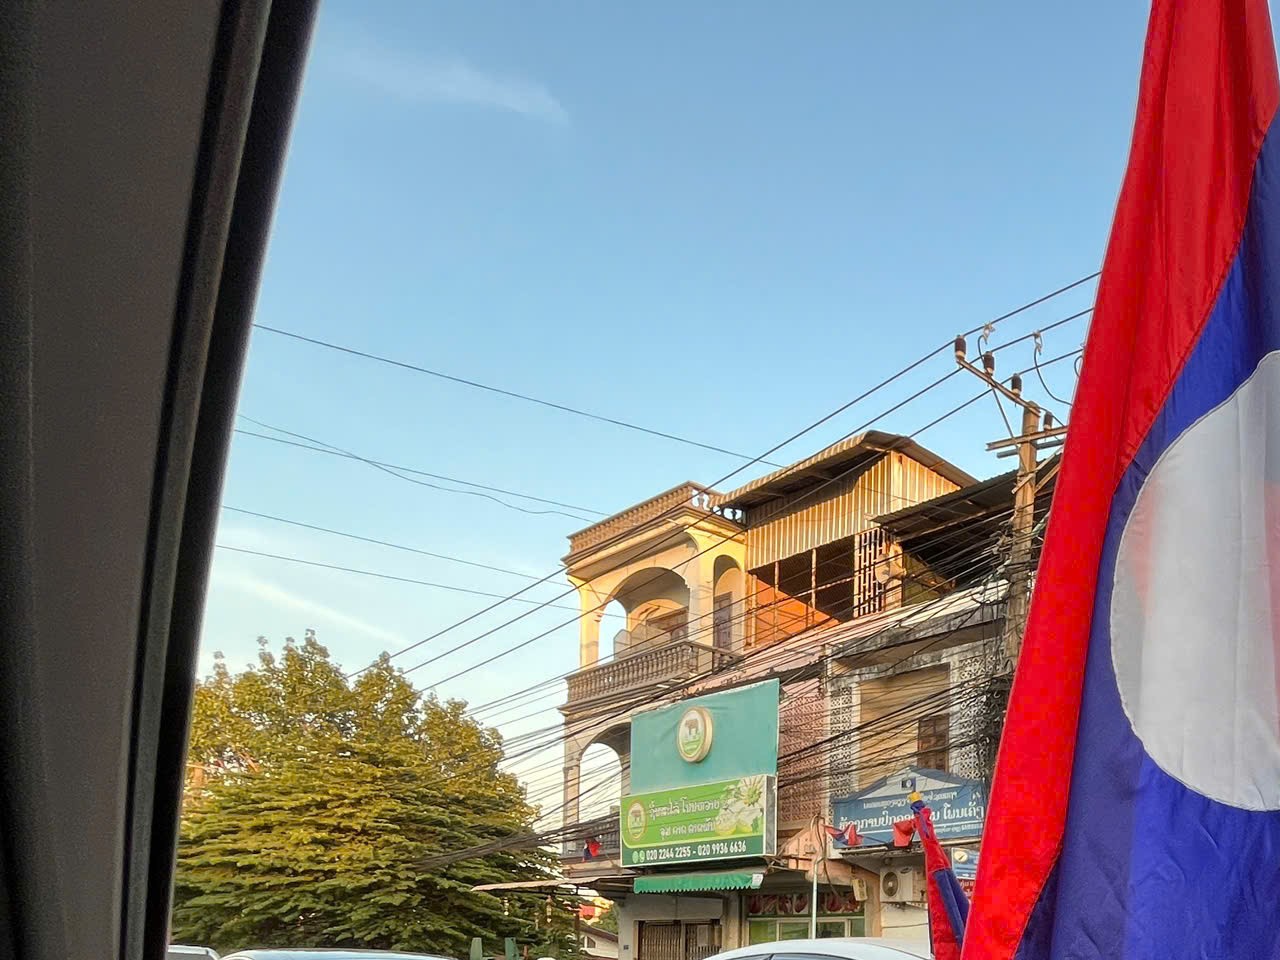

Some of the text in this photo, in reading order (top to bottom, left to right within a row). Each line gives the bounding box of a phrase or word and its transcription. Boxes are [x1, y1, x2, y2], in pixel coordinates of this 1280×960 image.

[646, 850, 657, 860] 020
[675, 846, 691, 858] 2255
[698, 845, 711, 856] 020
